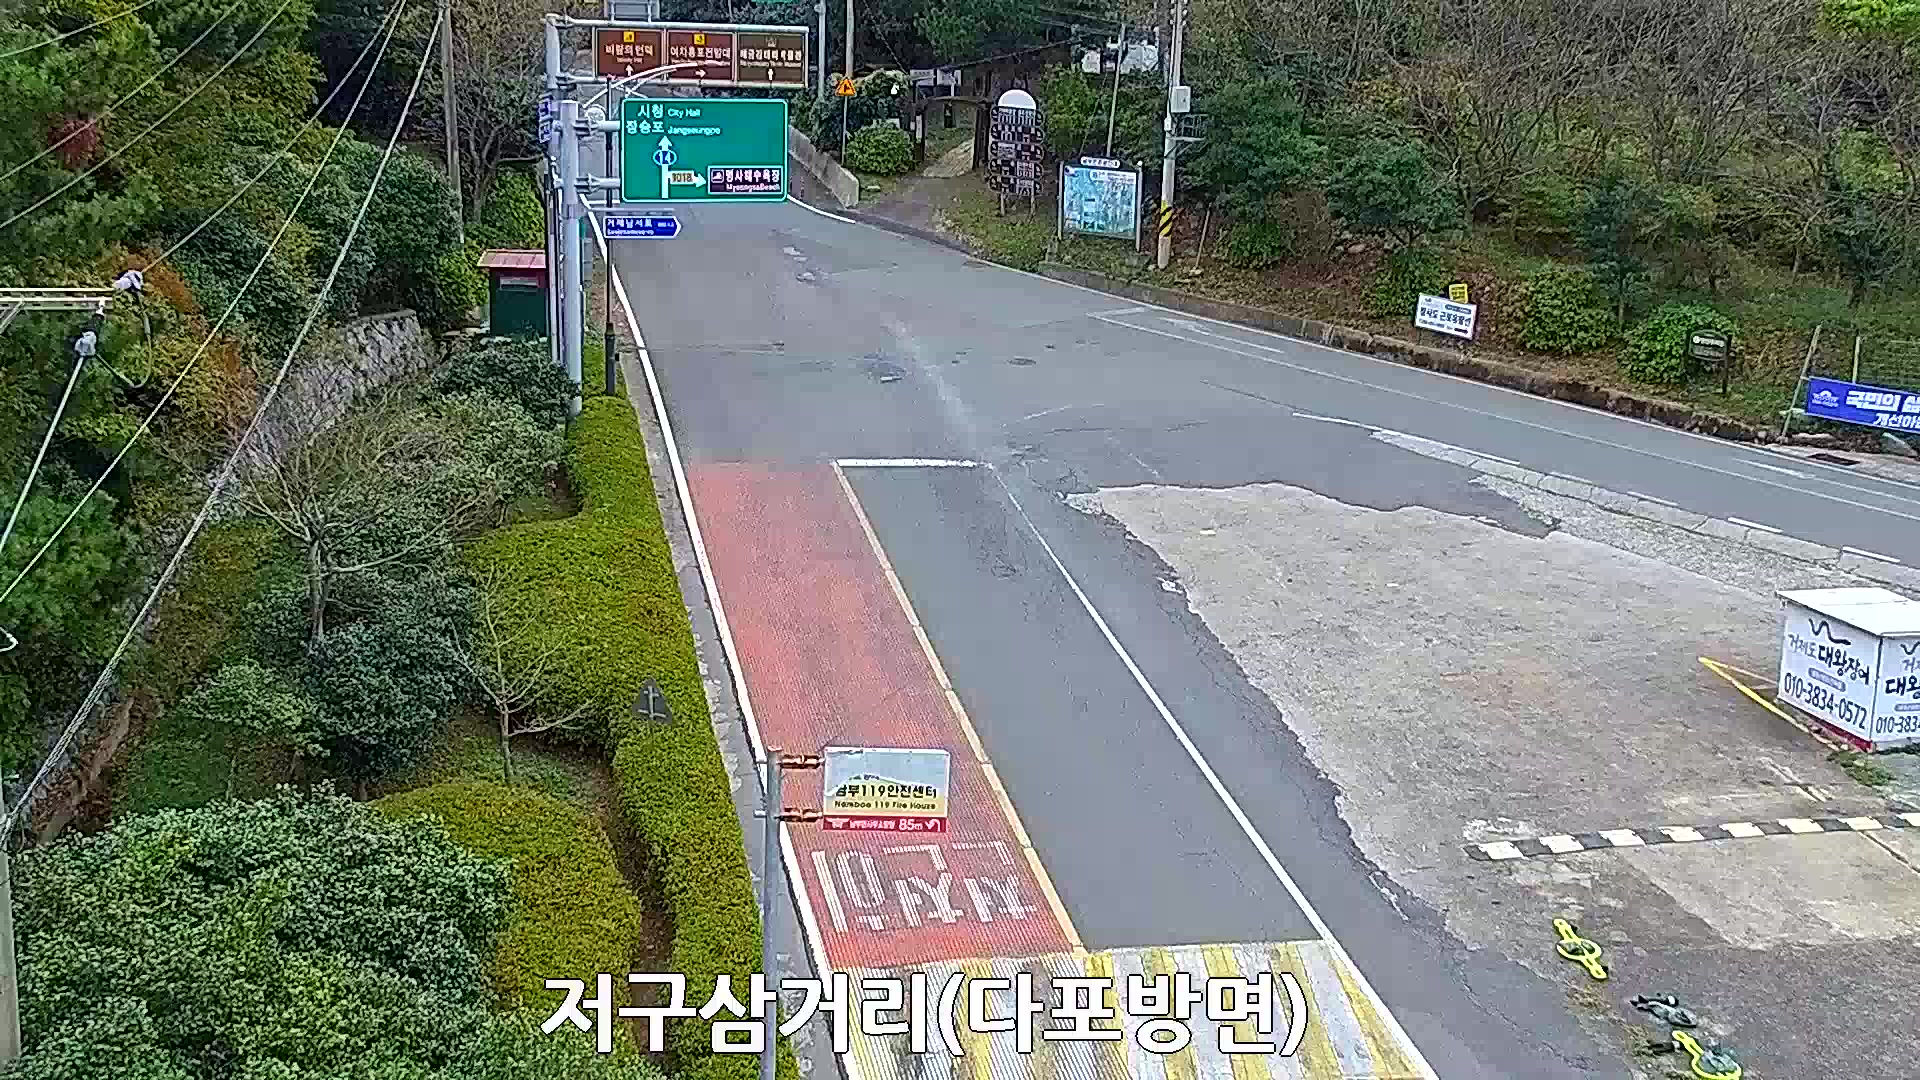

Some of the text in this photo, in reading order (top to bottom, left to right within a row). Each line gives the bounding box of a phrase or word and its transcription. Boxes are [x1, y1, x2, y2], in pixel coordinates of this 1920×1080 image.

[637, 104, 664, 118] 시청
[667, 108, 701, 118] City Hall
[626, 120, 664, 134] 장승포
[658, 151, 671, 165] 14
[672, 172, 693, 182] 1018
[725, 169, 780, 183] 명사해수욕장
[1846, 390, 1901, 412] 국민의
[1788, 633, 1817, 659] 거제도
[1818, 644, 1870, 685] 대왕장어
[1784, 672, 1868, 730] 010-3834-0572
[874, 801, 890, 809] 119
[898, 818, 923, 831] 85m
